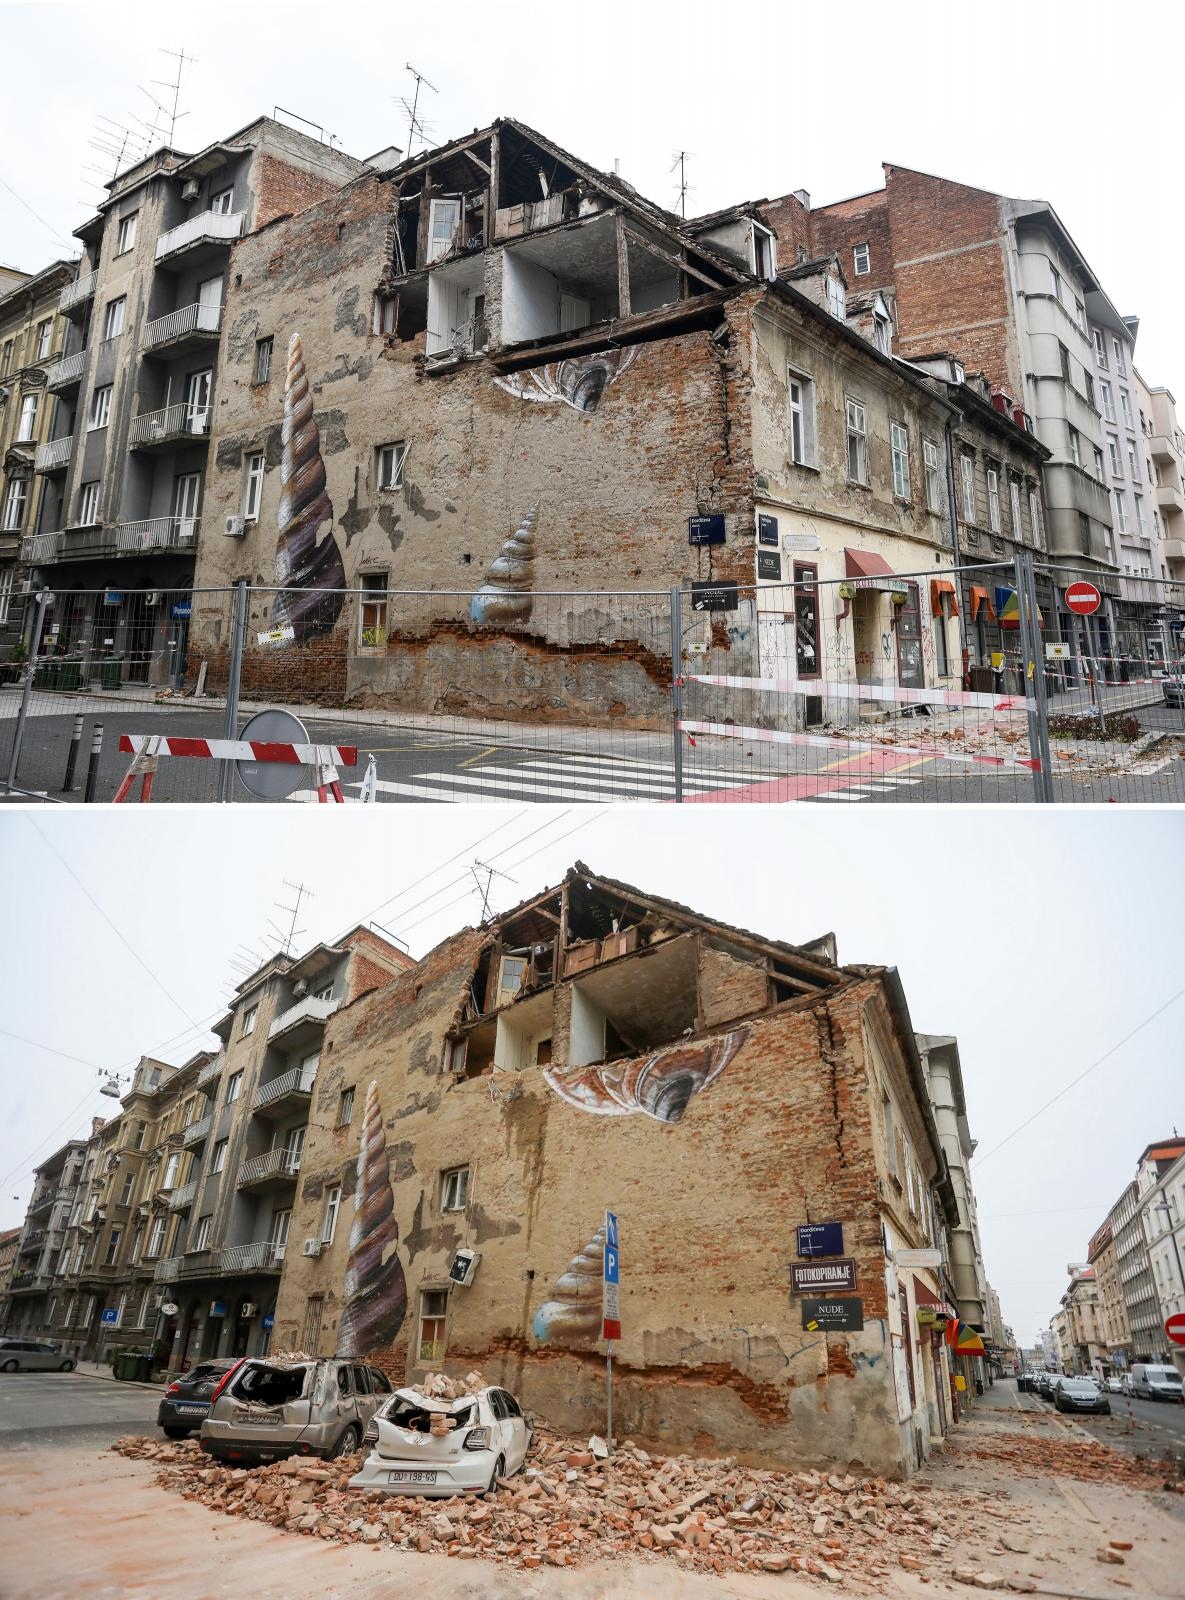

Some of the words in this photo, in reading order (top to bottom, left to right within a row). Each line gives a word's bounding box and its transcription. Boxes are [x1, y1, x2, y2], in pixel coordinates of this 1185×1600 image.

[608, 1253, 616, 1275] P
[795, 1265, 851, 1282] FOTOKOPIRANJE
[105, 1311, 115, 1319] P
[818, 1305, 844, 1314] NUDE
